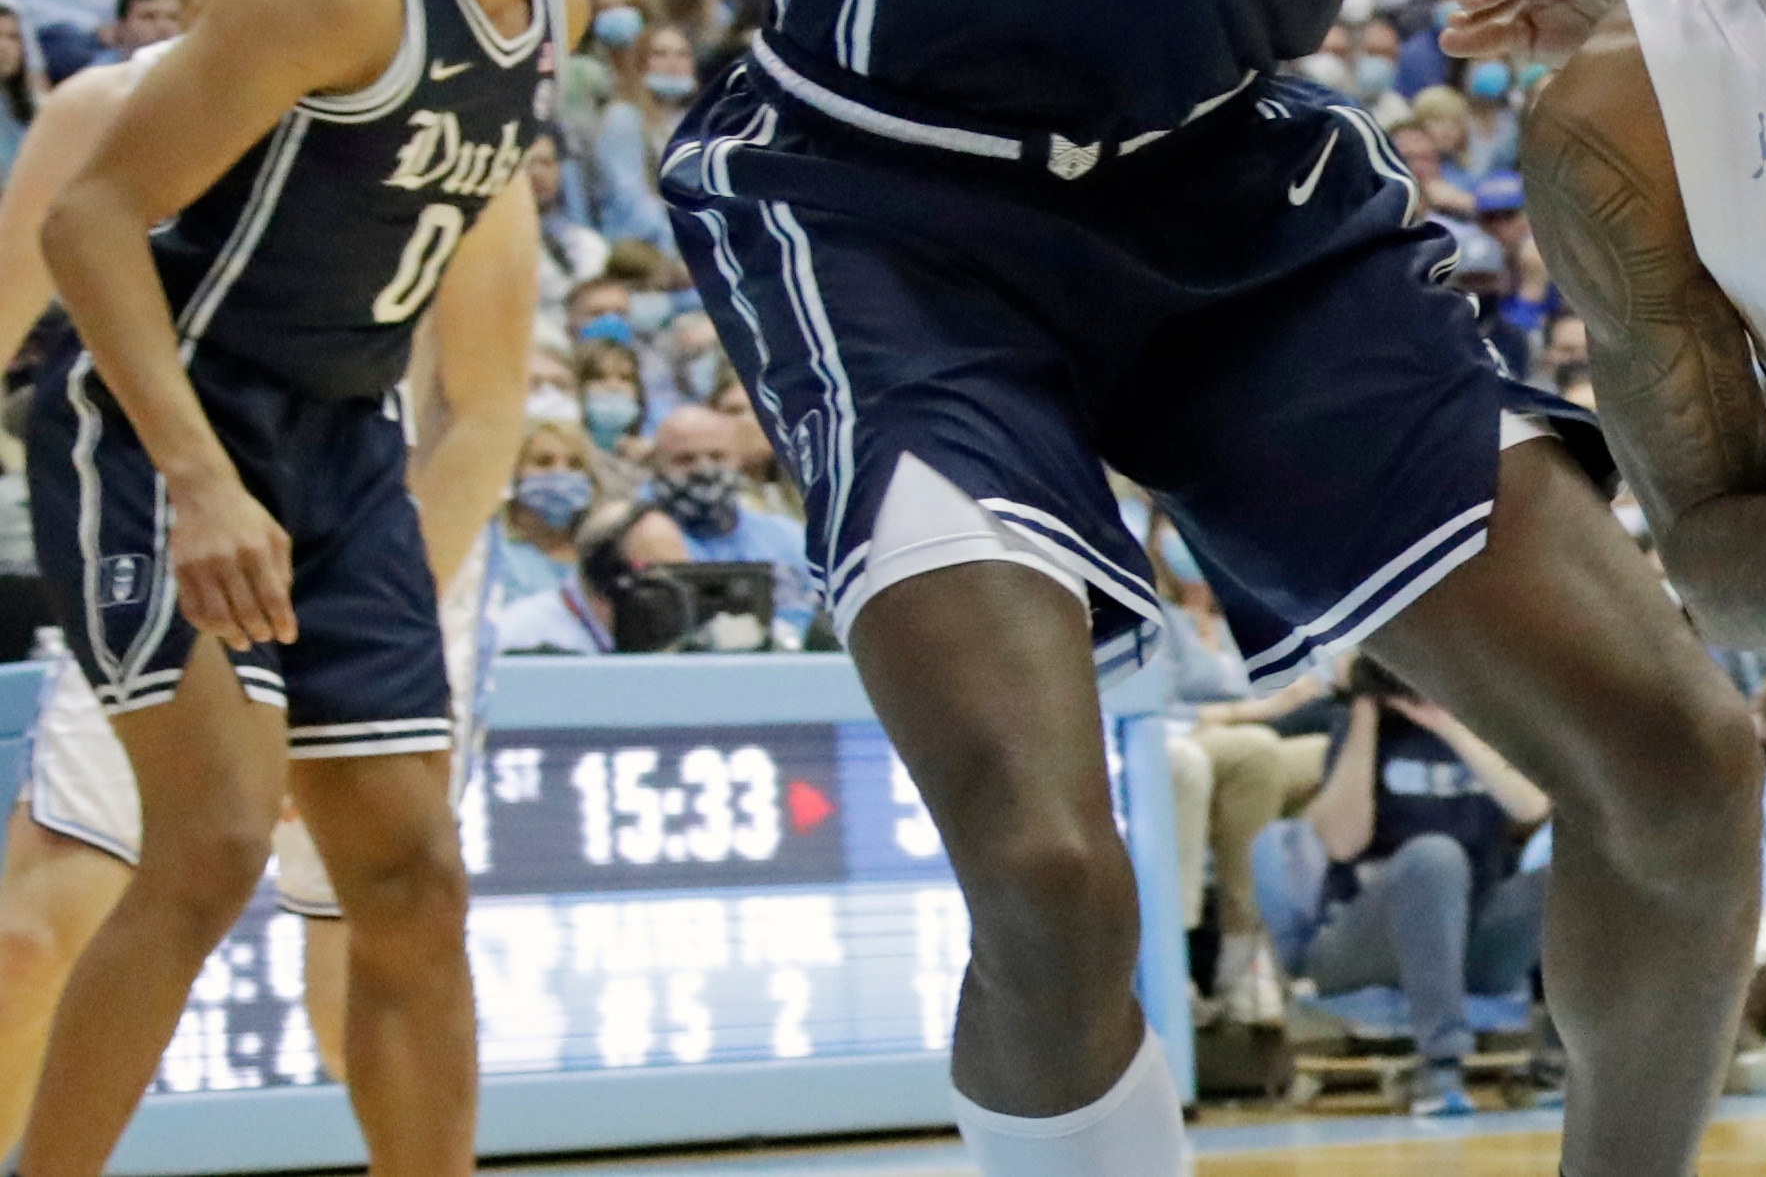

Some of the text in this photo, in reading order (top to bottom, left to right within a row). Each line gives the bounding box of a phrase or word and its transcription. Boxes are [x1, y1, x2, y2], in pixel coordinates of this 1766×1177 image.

[381, 109, 522, 197] Duk
[371, 202, 465, 323] 0
[570, 744, 781, 865] 15:33
